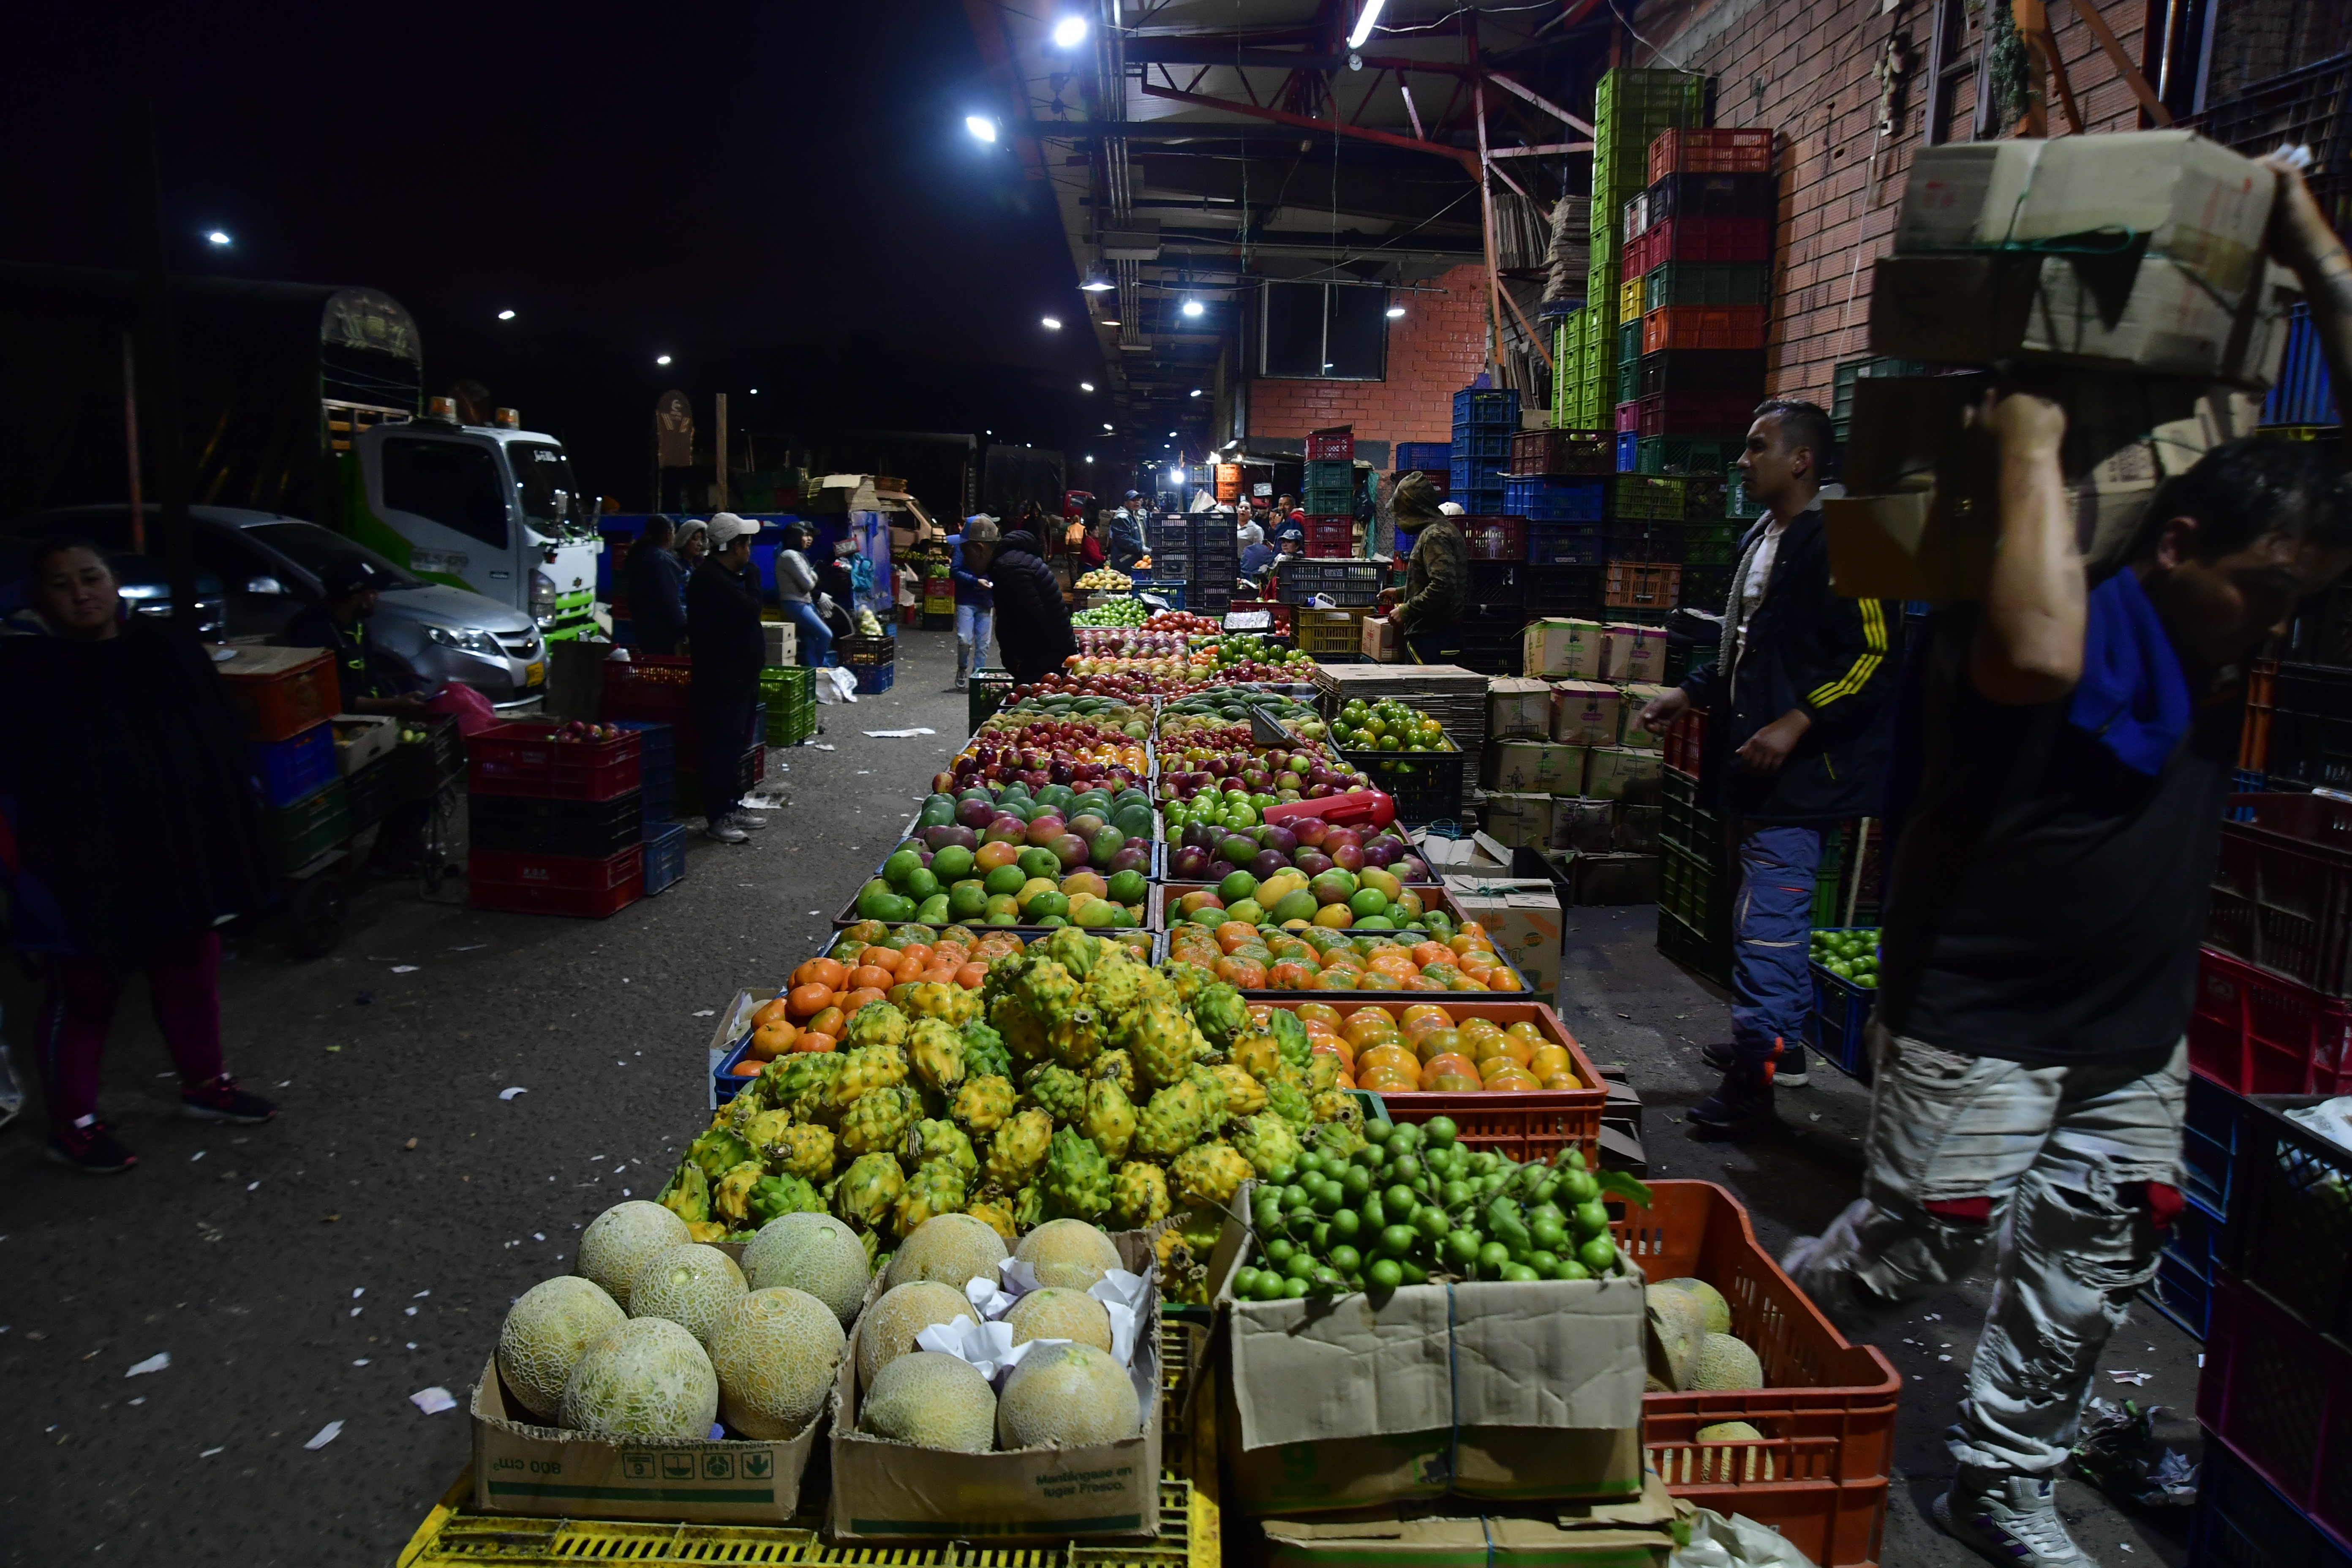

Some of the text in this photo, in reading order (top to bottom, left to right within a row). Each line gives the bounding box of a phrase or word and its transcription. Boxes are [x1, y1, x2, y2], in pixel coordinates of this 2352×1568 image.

[530, 1461, 561, 1475] 800
[1116, 1467, 1132, 1476] en
[1043, 1486, 1075, 1498] lugar
